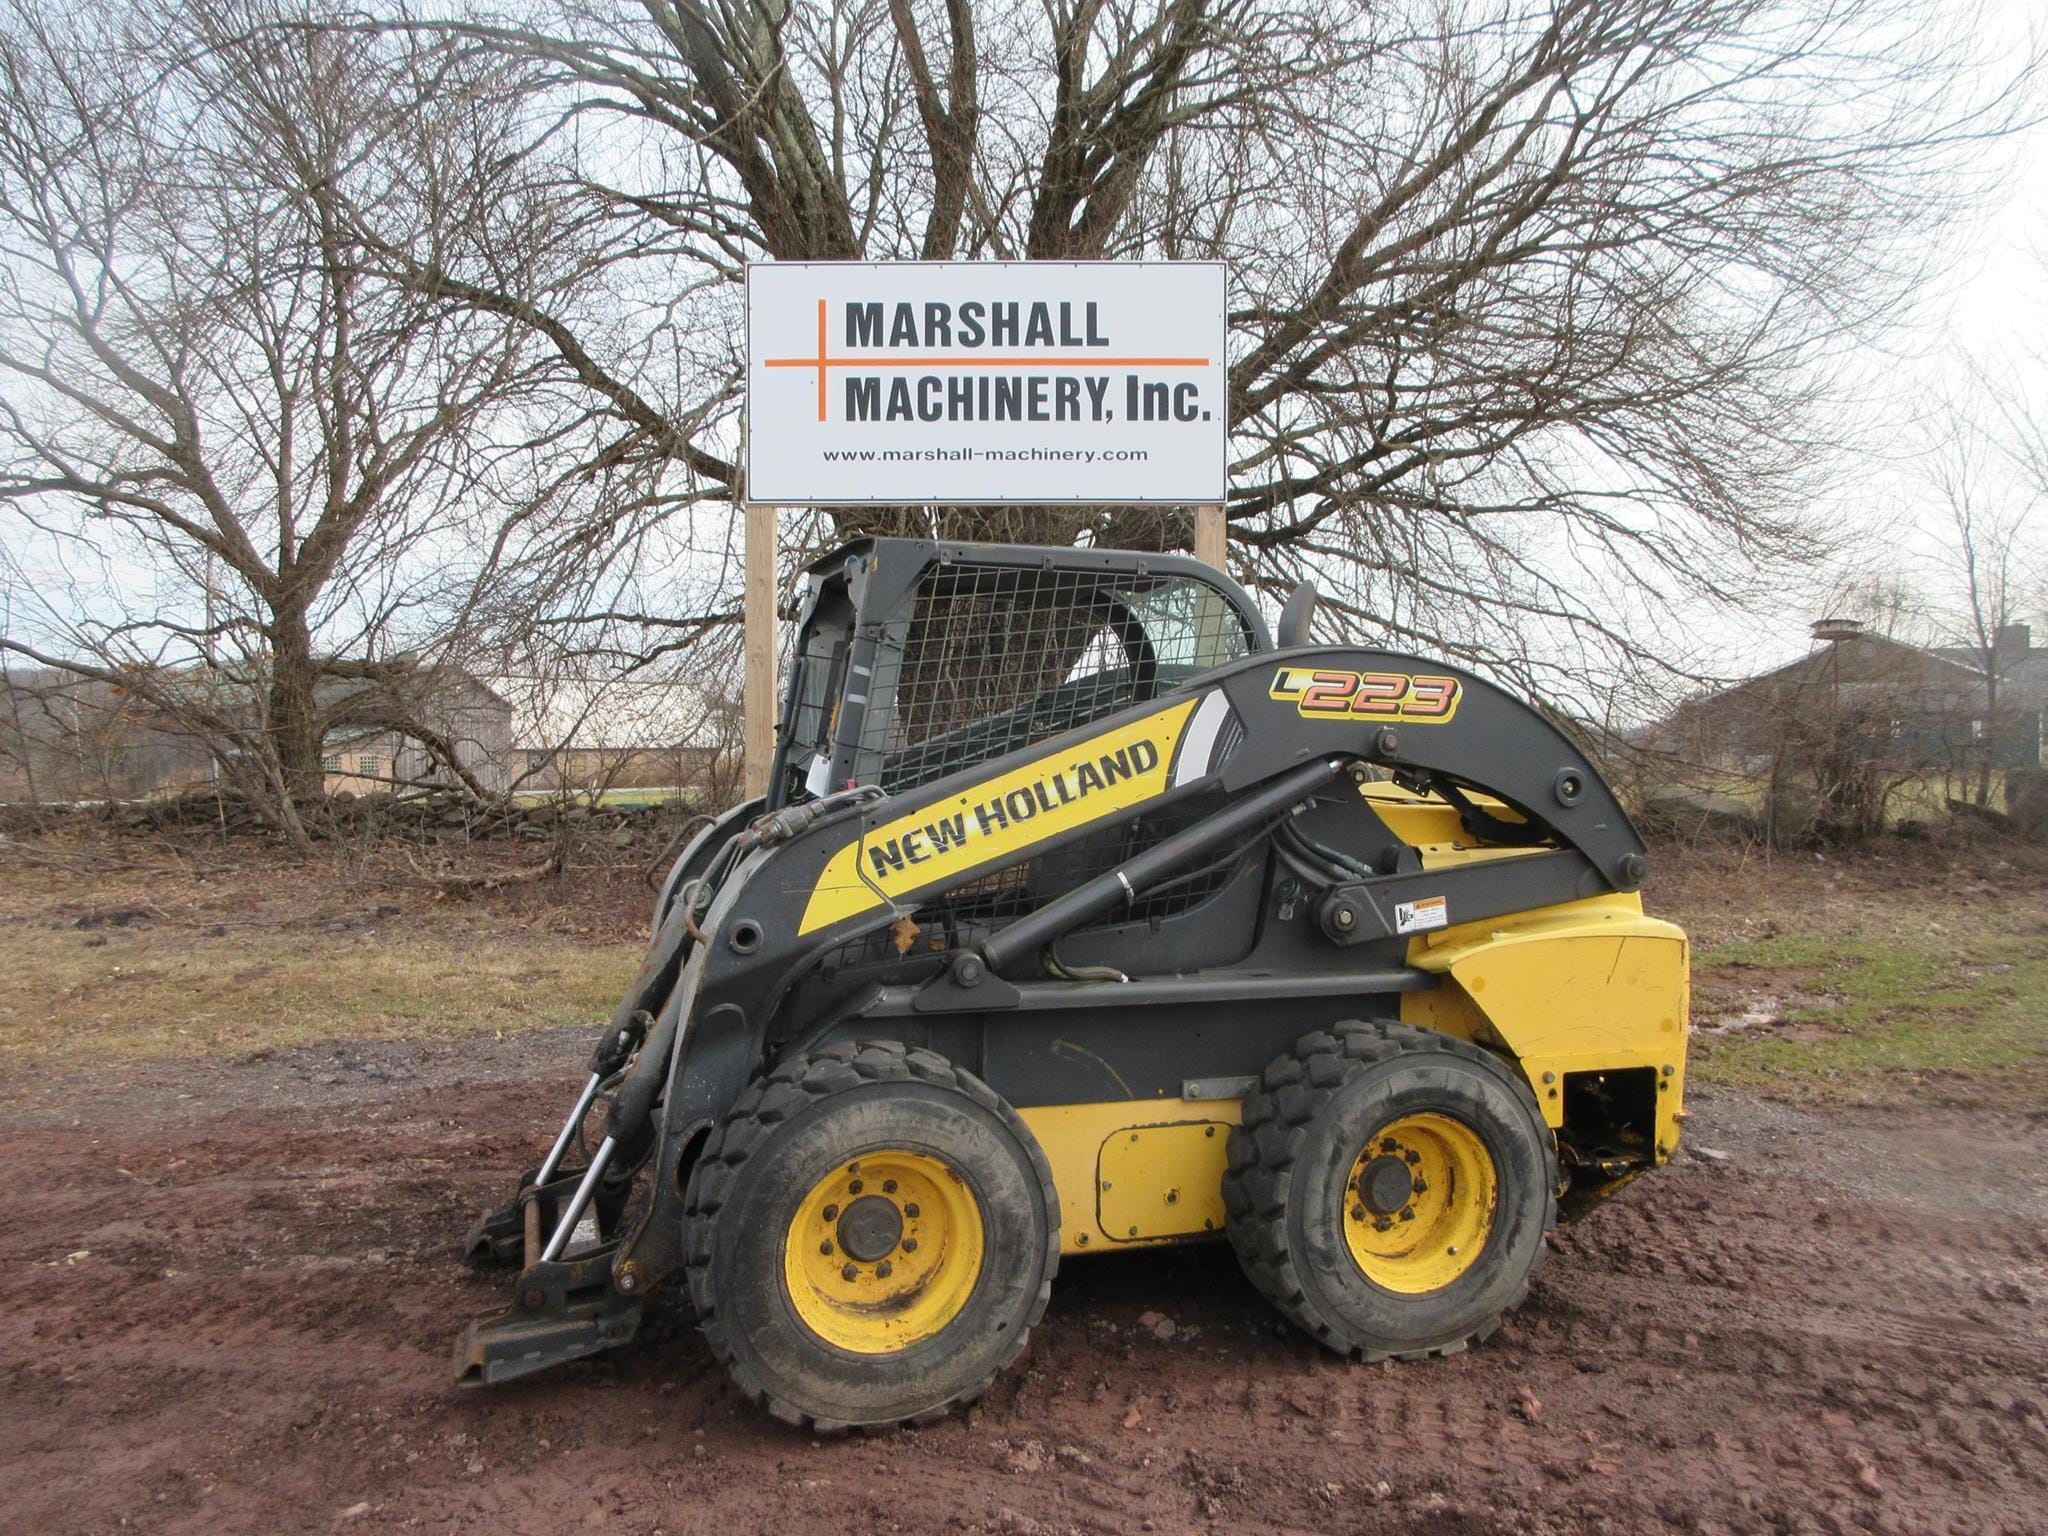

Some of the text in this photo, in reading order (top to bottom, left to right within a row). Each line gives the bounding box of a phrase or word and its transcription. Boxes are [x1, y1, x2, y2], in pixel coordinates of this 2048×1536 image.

[846, 302, 1109, 347] MARSHALL
[846, 375, 1211, 424] MACHINERY, Inc.
[823, 447, 1148, 464] www.marshall-machinery.com
[868, 739, 1158, 878] NEW HOLLAND
